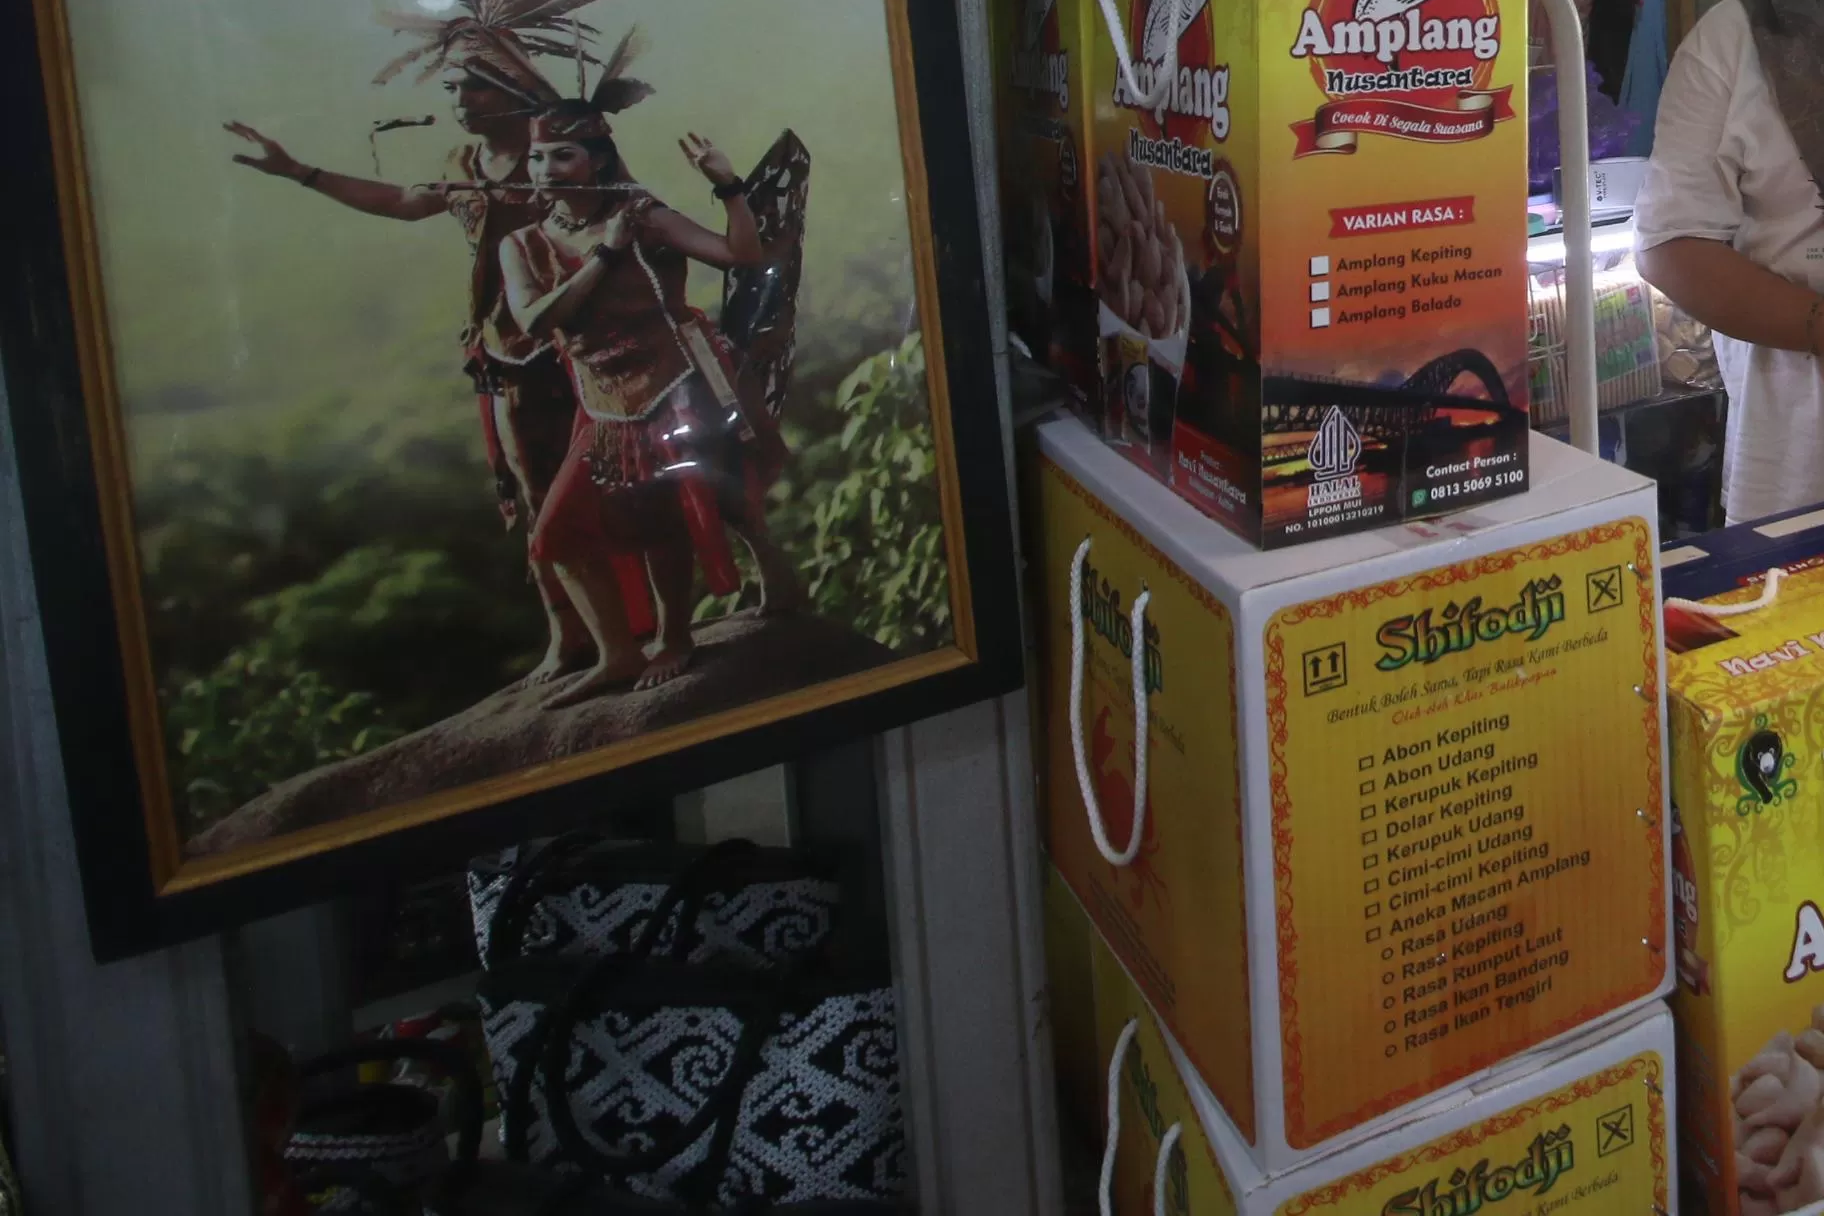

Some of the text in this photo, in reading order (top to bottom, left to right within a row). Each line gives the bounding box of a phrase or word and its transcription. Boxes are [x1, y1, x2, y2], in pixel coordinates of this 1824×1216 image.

[1289, 7, 1499, 63] Amplang
[1325, 66, 1473, 95] Nusantara
[1331, 111, 1484, 135] Cocok Di Segala Suasana
[1129, 128, 1214, 180] Nusantara
[1343, 206, 1455, 231] VARIAN RASA
[1336, 245, 1473, 273] Amplang Kepiting
[1336, 266, 1503, 298] Amplang Kuku Macan
[1336, 294, 1462, 325] Amplang Balado
[1308, 476, 1362, 498] HALAL
[1426, 454, 1511, 479] Contact Person
[1431, 469, 1524, 500] 0813 5069 5100
[1285, 523, 1304, 534] NO.
[1308, 499, 1363, 519] LPPOM MUI
[1374, 574, 1566, 672] Shifodji
[1327, 696, 1380, 725] Bentuk
[1380, 686, 1419, 709] Boleh
[1462, 663, 1492, 684] Tapi
[1527, 646, 1561, 666] Kami
[1561, 629, 1609, 654] Berbeda
[1719, 638, 1813, 677] Navi
[1382, 714, 1510, 765] Abon Kepiting
[1383, 742, 1496, 790] Abon Udang
[1384, 752, 1539, 814] Kerupuk Kepiting
[1386, 784, 1513, 839] Dolar Kepiting
[1386, 804, 1525, 863] Kerupuk Udang
[1387, 825, 1533, 887] Cimi-cimi Udang
[1388, 841, 1550, 912] Cimi-cimi Kepiting
[1389, 849, 1591, 936] Aneka Macam Amplang
[1401, 904, 1509, 956] Rasa Udang
[1402, 921, 1525, 980] Rasa Kepiting
[1403, 927, 1564, 1004] Rasa Rumput Laut
[1404, 949, 1570, 1028] Rasa Ikan Bandeng
[1404, 976, 1553, 1052] Rasa Ikan Tengiri
